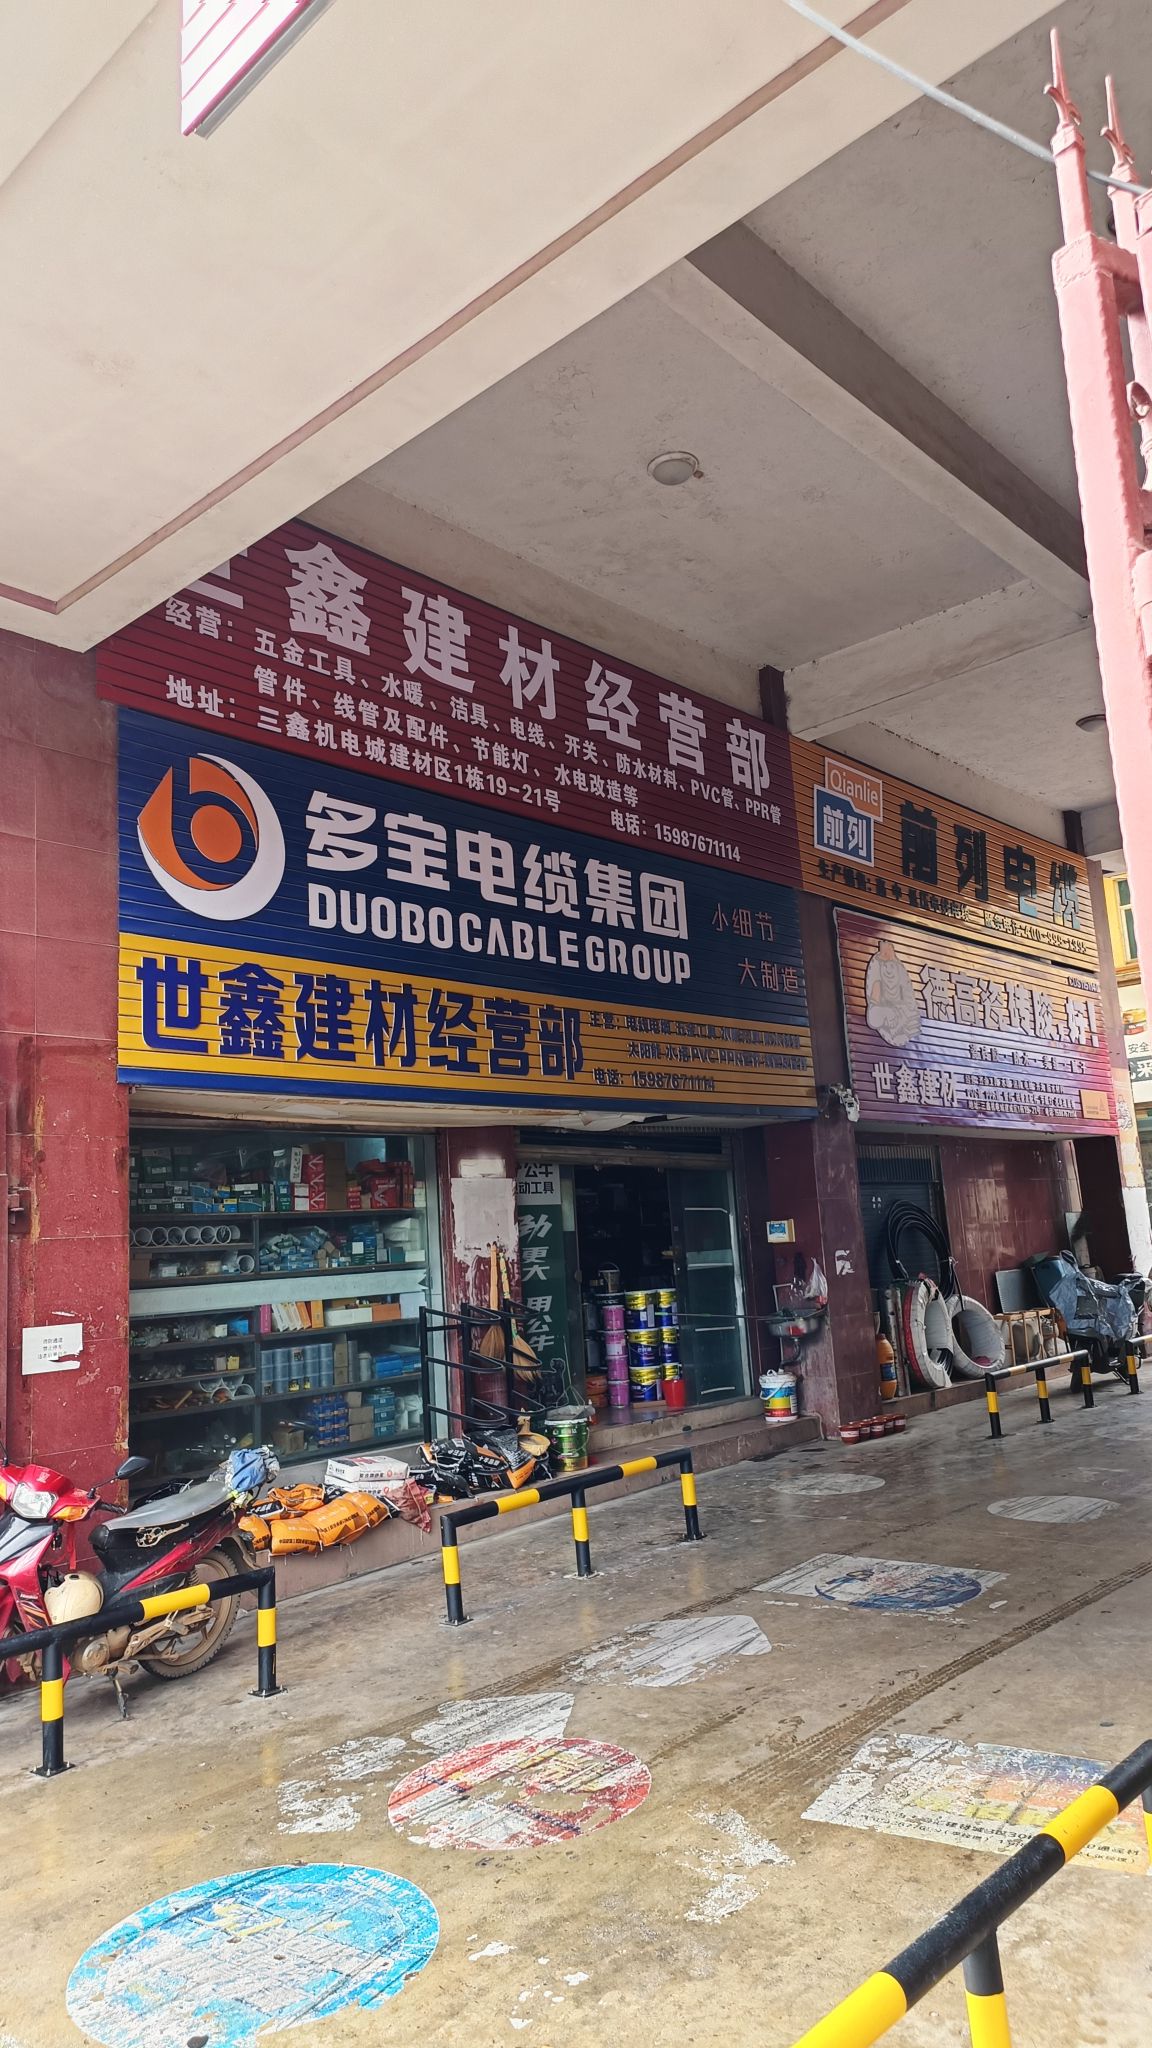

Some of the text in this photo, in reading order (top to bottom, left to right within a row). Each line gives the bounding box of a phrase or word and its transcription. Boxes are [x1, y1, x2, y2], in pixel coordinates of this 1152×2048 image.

[183, 540, 771, 797] 鑫建材经营部
[166, 675, 235, 719] 地址：
[830, 769, 879, 806] Qianlie
[823, 803, 867, 857] 前列
[305, 790, 689, 940] 多宝电缆集团
[901, 800, 1081, 930] 前列电缆
[711, 903, 775, 942] 小细节
[738, 957, 800, 994] 大制造
[135, 955, 584, 1081] 世鑫建材经营部
[872, 1061, 961, 1108] 世鑫建材
[516, 1180, 555, 1195] 动工具
